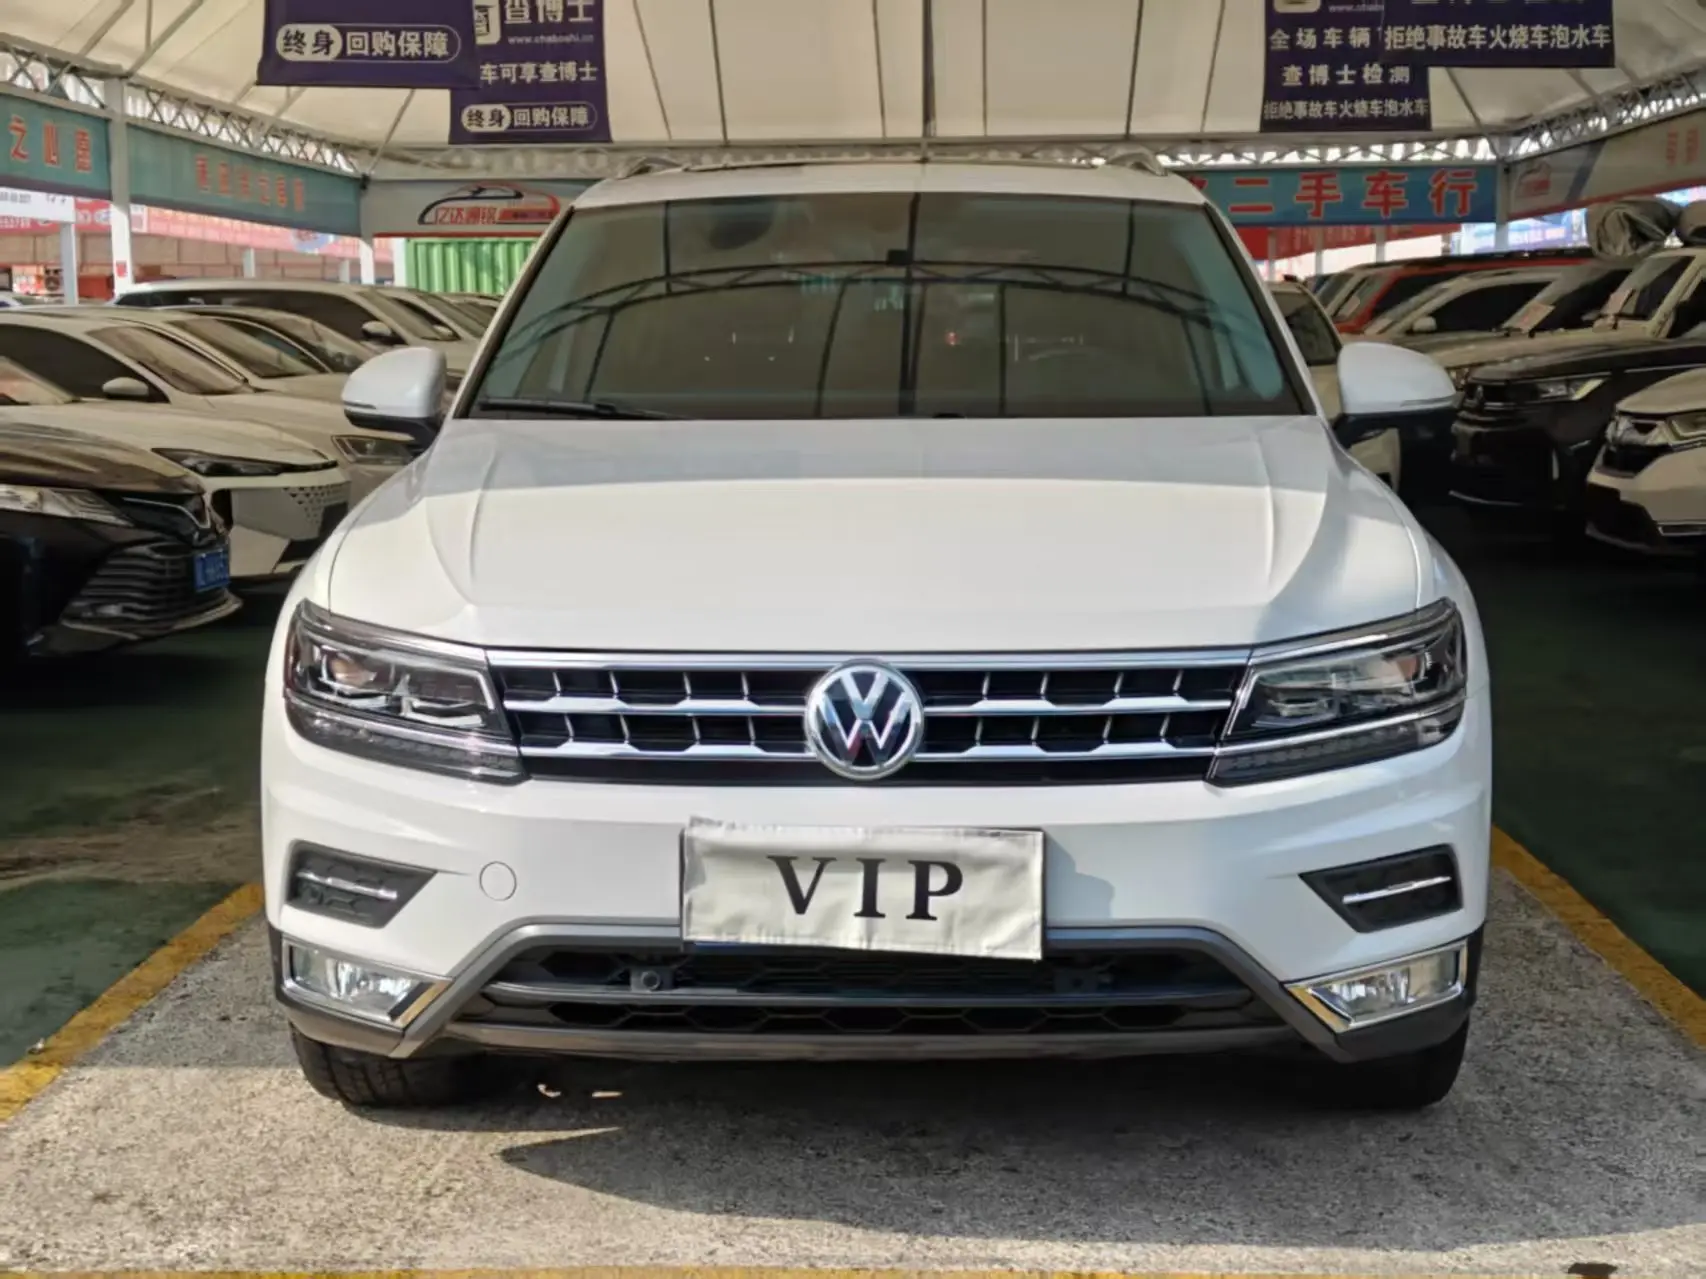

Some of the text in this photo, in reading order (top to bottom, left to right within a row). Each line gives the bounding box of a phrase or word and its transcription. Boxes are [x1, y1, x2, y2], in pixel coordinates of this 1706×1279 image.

[282, 29, 449, 57] 终身回购保障
[1269, 26, 1371, 50] 全场车辆
[1384, 24, 1612, 50] 拒绝事故车火烧车泡水车
[479, 60, 598, 85] 车可享查博士
[1282, 63, 1411, 87] 查博士检测
[467, 106, 589, 128] 终身回购保障
[1263, 98, 1429, 120] 拒绝事故车火烧车泡水车
[1188, 168, 1479, 218] 二手车行
[767, 855, 963, 922] VIP
